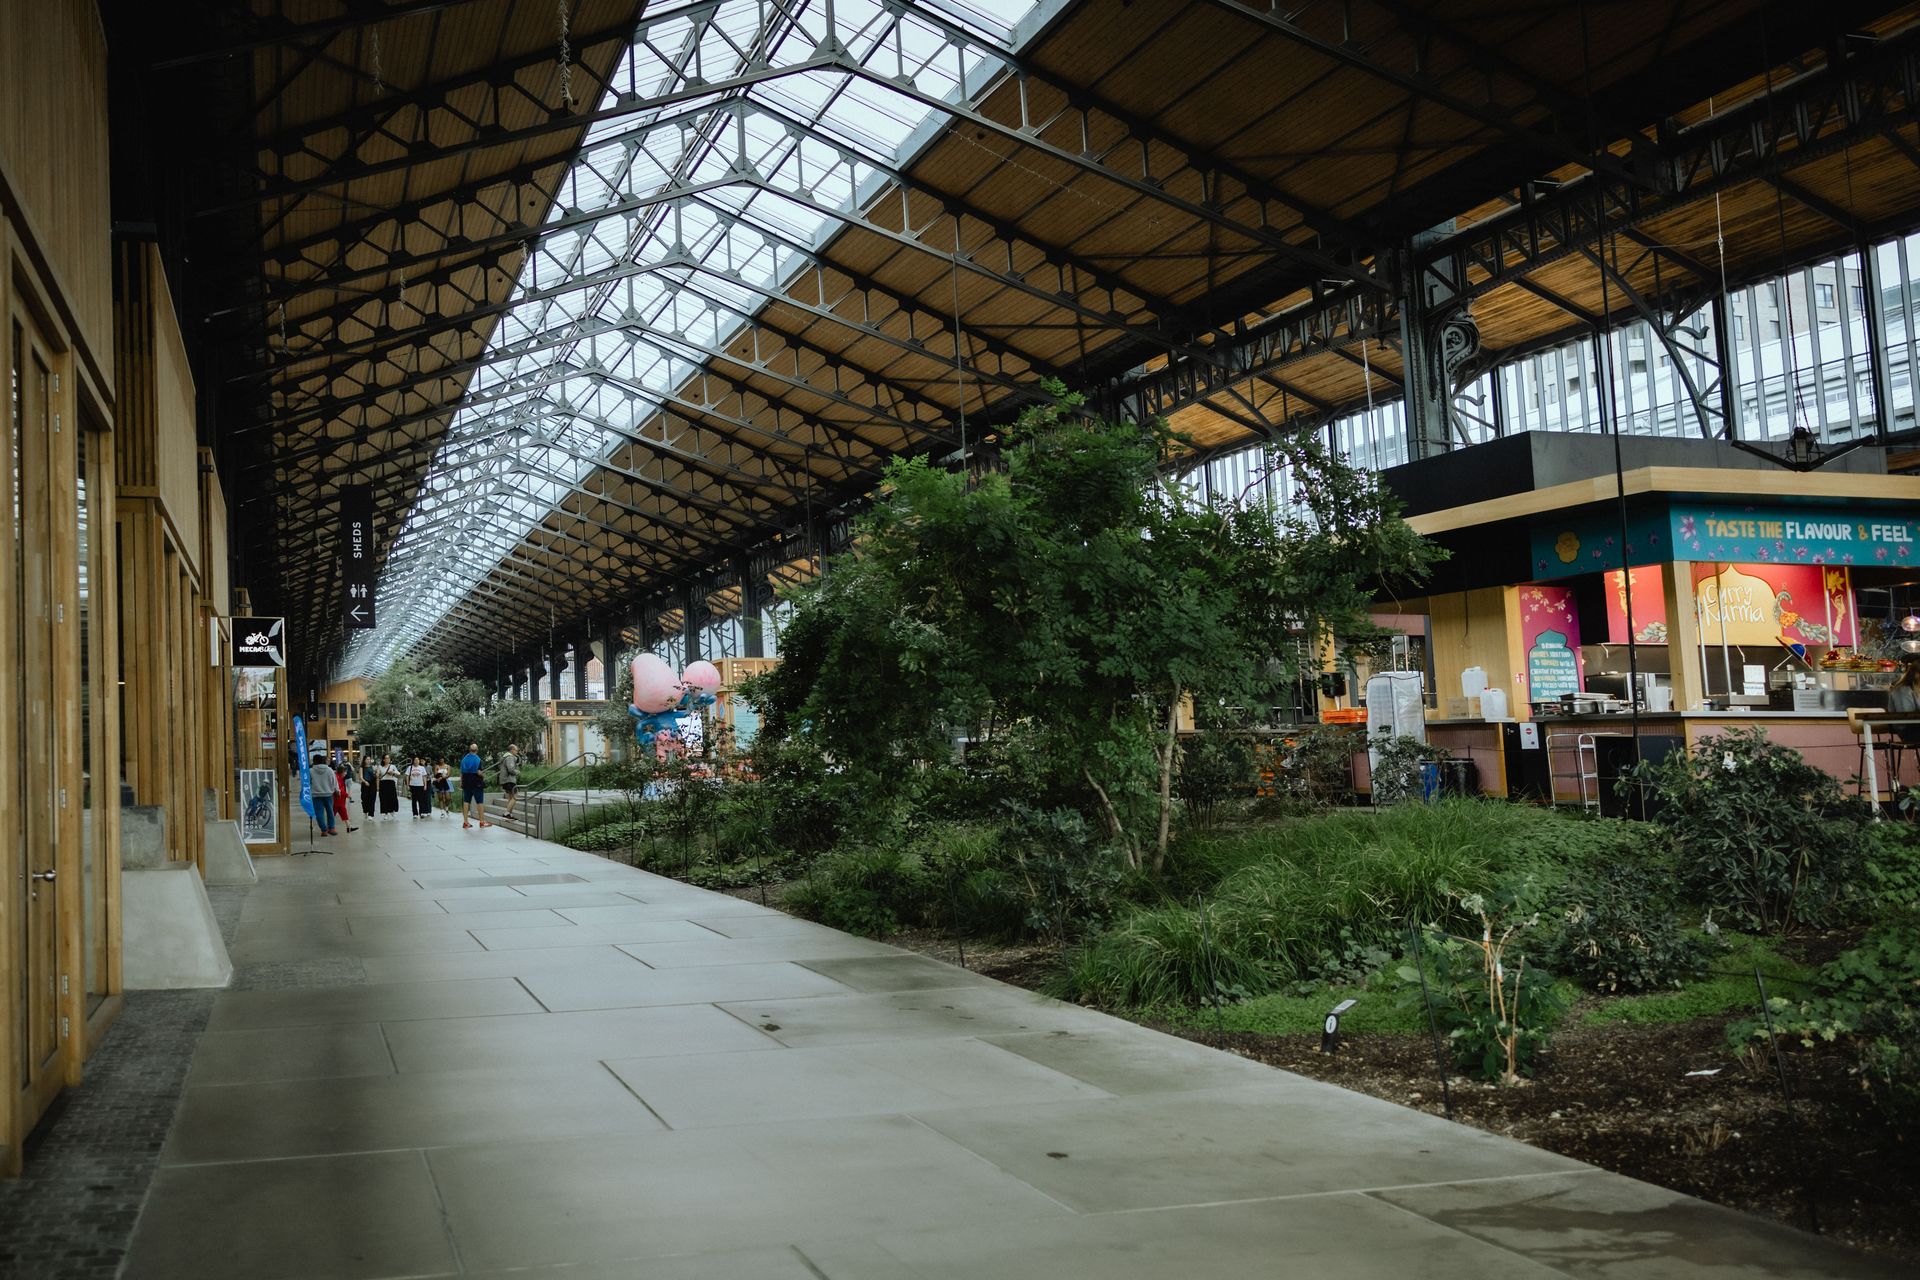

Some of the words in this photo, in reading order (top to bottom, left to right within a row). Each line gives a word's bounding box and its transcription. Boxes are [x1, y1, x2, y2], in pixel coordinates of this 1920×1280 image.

[352, 521, 362, 559] SHEDS
[1705, 519, 1756, 538] TASTE
[1757, 521, 1783, 539] THE
[1785, 521, 1852, 541] FLAVOUR
[1857, 524, 1868, 540] &
[1871, 524, 1913, 542] FEEL
[1705, 584, 1752, 606] Curry
[1703, 595, 1765, 627] Karma
